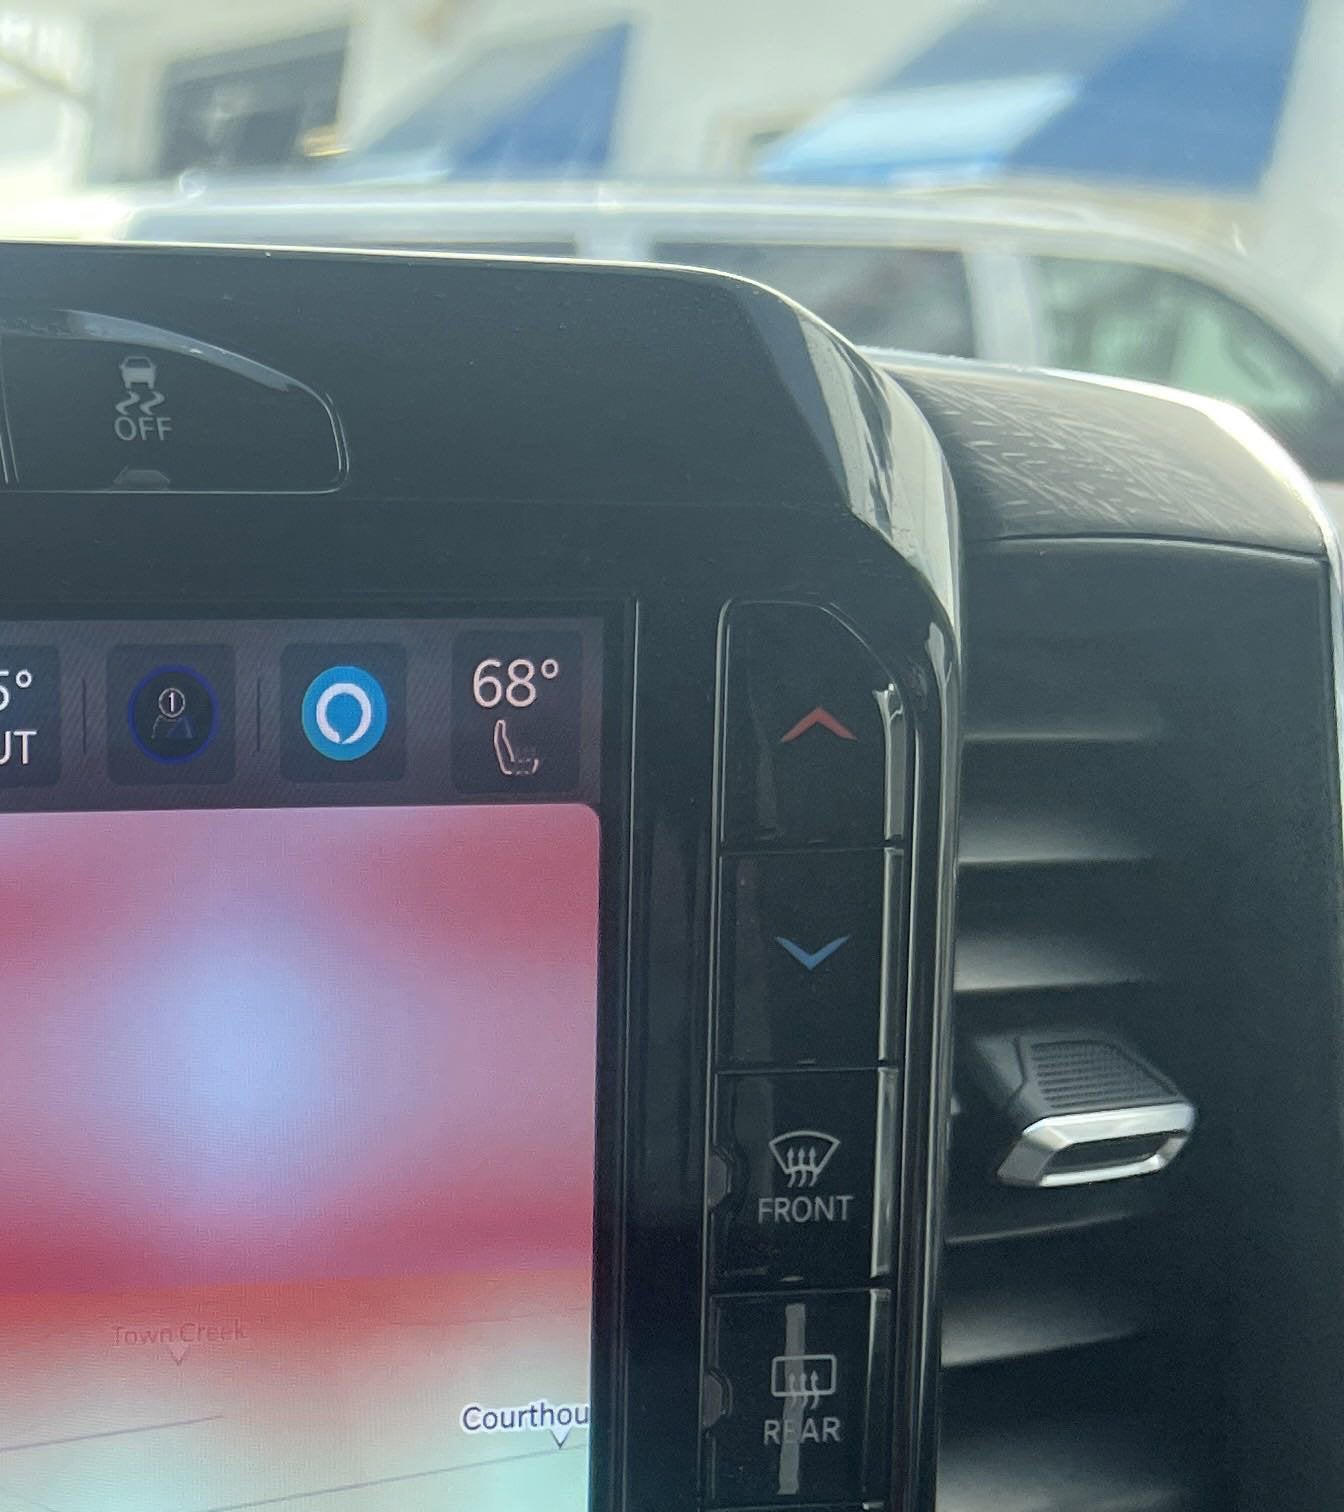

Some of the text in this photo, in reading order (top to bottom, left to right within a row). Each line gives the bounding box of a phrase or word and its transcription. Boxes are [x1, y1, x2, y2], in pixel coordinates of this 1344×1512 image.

[114, 416, 172, 441] OFF
[471, 659, 559, 708] 68°
[758, 1196, 852, 1224] FRONT
[115, 1320, 246, 1347] Town Creek
[463, 1403, 589, 1432] Courthou
[764, 1418, 840, 1446] REAR
